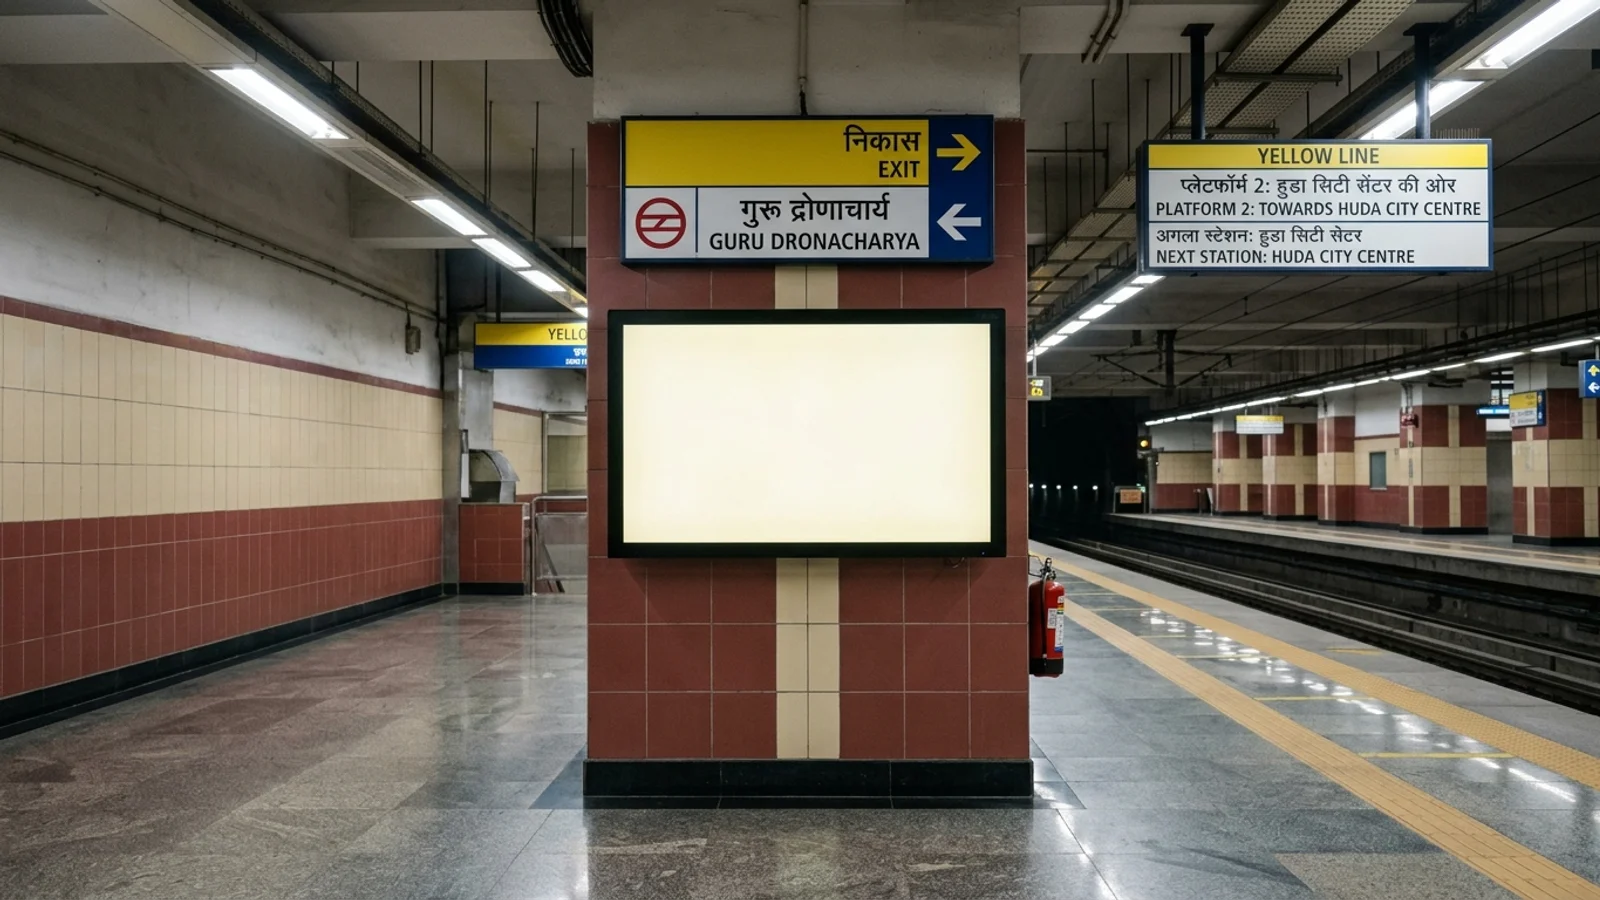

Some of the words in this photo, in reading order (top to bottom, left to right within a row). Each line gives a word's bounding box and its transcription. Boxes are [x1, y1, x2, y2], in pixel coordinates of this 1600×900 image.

[843, 124, 922, 152] निकास
[1257, 147, 1333, 164] YELLOW
[1339, 147, 1380, 164] LINE
[879, 160, 921, 178] EXIT
[1180, 173, 1248, 194] प्लेटफॉर्म
[1253, 177, 1270, 194] 2:
[1276, 178, 1307, 199] हुडा
[1312, 173, 1351, 193] सिटी
[1356, 173, 1393, 193] सेंटर
[1398, 173, 1420, 193] की
[1426, 173, 1457, 193] ओर
[789, 192, 890, 223] द्रोणाचार्य
[1156, 201, 1236, 216] PLATFORM
[1241, 201, 1255, 216] 2:
[1259, 201, 1334, 216] TOWARDS
[1339, 201, 1381, 216] HUDA
[1387, 201, 1419, 216] CITY
[1424, 201, 1481, 216] CENTRE
[709, 232, 764, 251] GURU
[772, 232, 920, 251] DRONACHARYA
[1156, 229, 1199, 243] अगला
[1204, 225, 1253, 243] स्टेशन:
[1259, 229, 1286, 248] हुडा
[1291, 225, 1325, 243] सिटी
[1330, 225, 1363, 243] सेटर
[1156, 249, 1196, 264] NEXT
[1200, 249, 1267, 264] STATION:
[1272, 249, 1315, 264] HUDA
[1320, 249, 1353, 264] CITY
[1357, 249, 1415, 264] CENTRE
